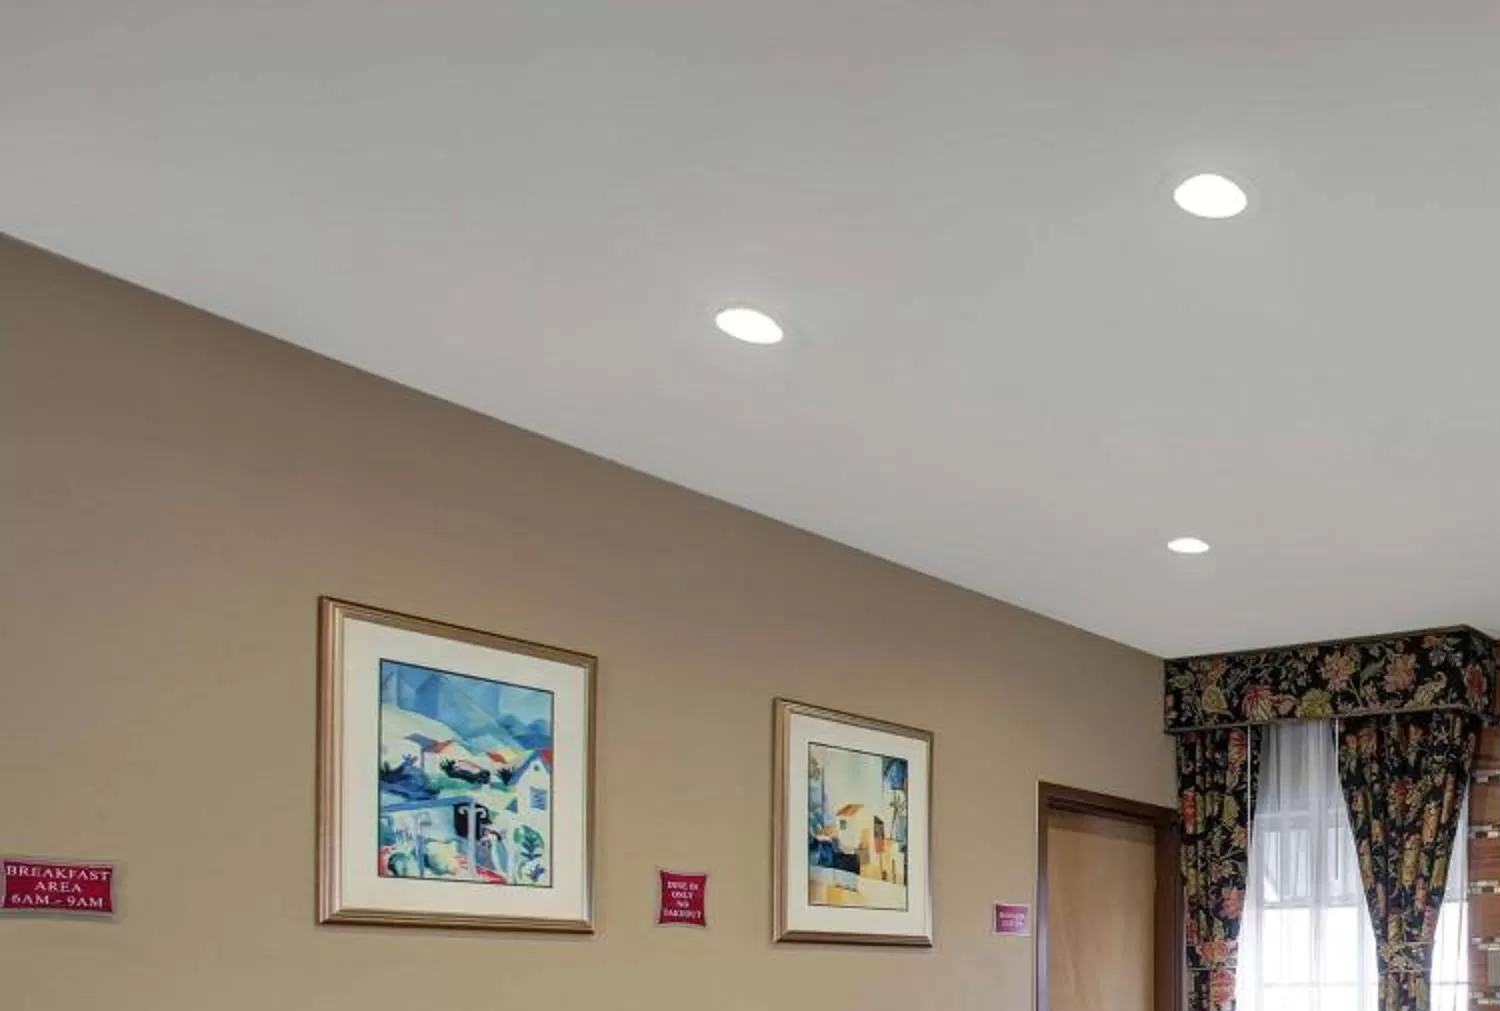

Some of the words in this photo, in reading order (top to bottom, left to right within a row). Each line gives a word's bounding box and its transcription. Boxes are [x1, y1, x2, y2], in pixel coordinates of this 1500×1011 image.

[7, 865, 111, 881] BREAKFAST
[34, 881, 82, 893] AREA
[11, 894, 50, 905] 6AM
[67, 895, 104, 908] 9AM
[671, 891, 693, 899] ONLY
